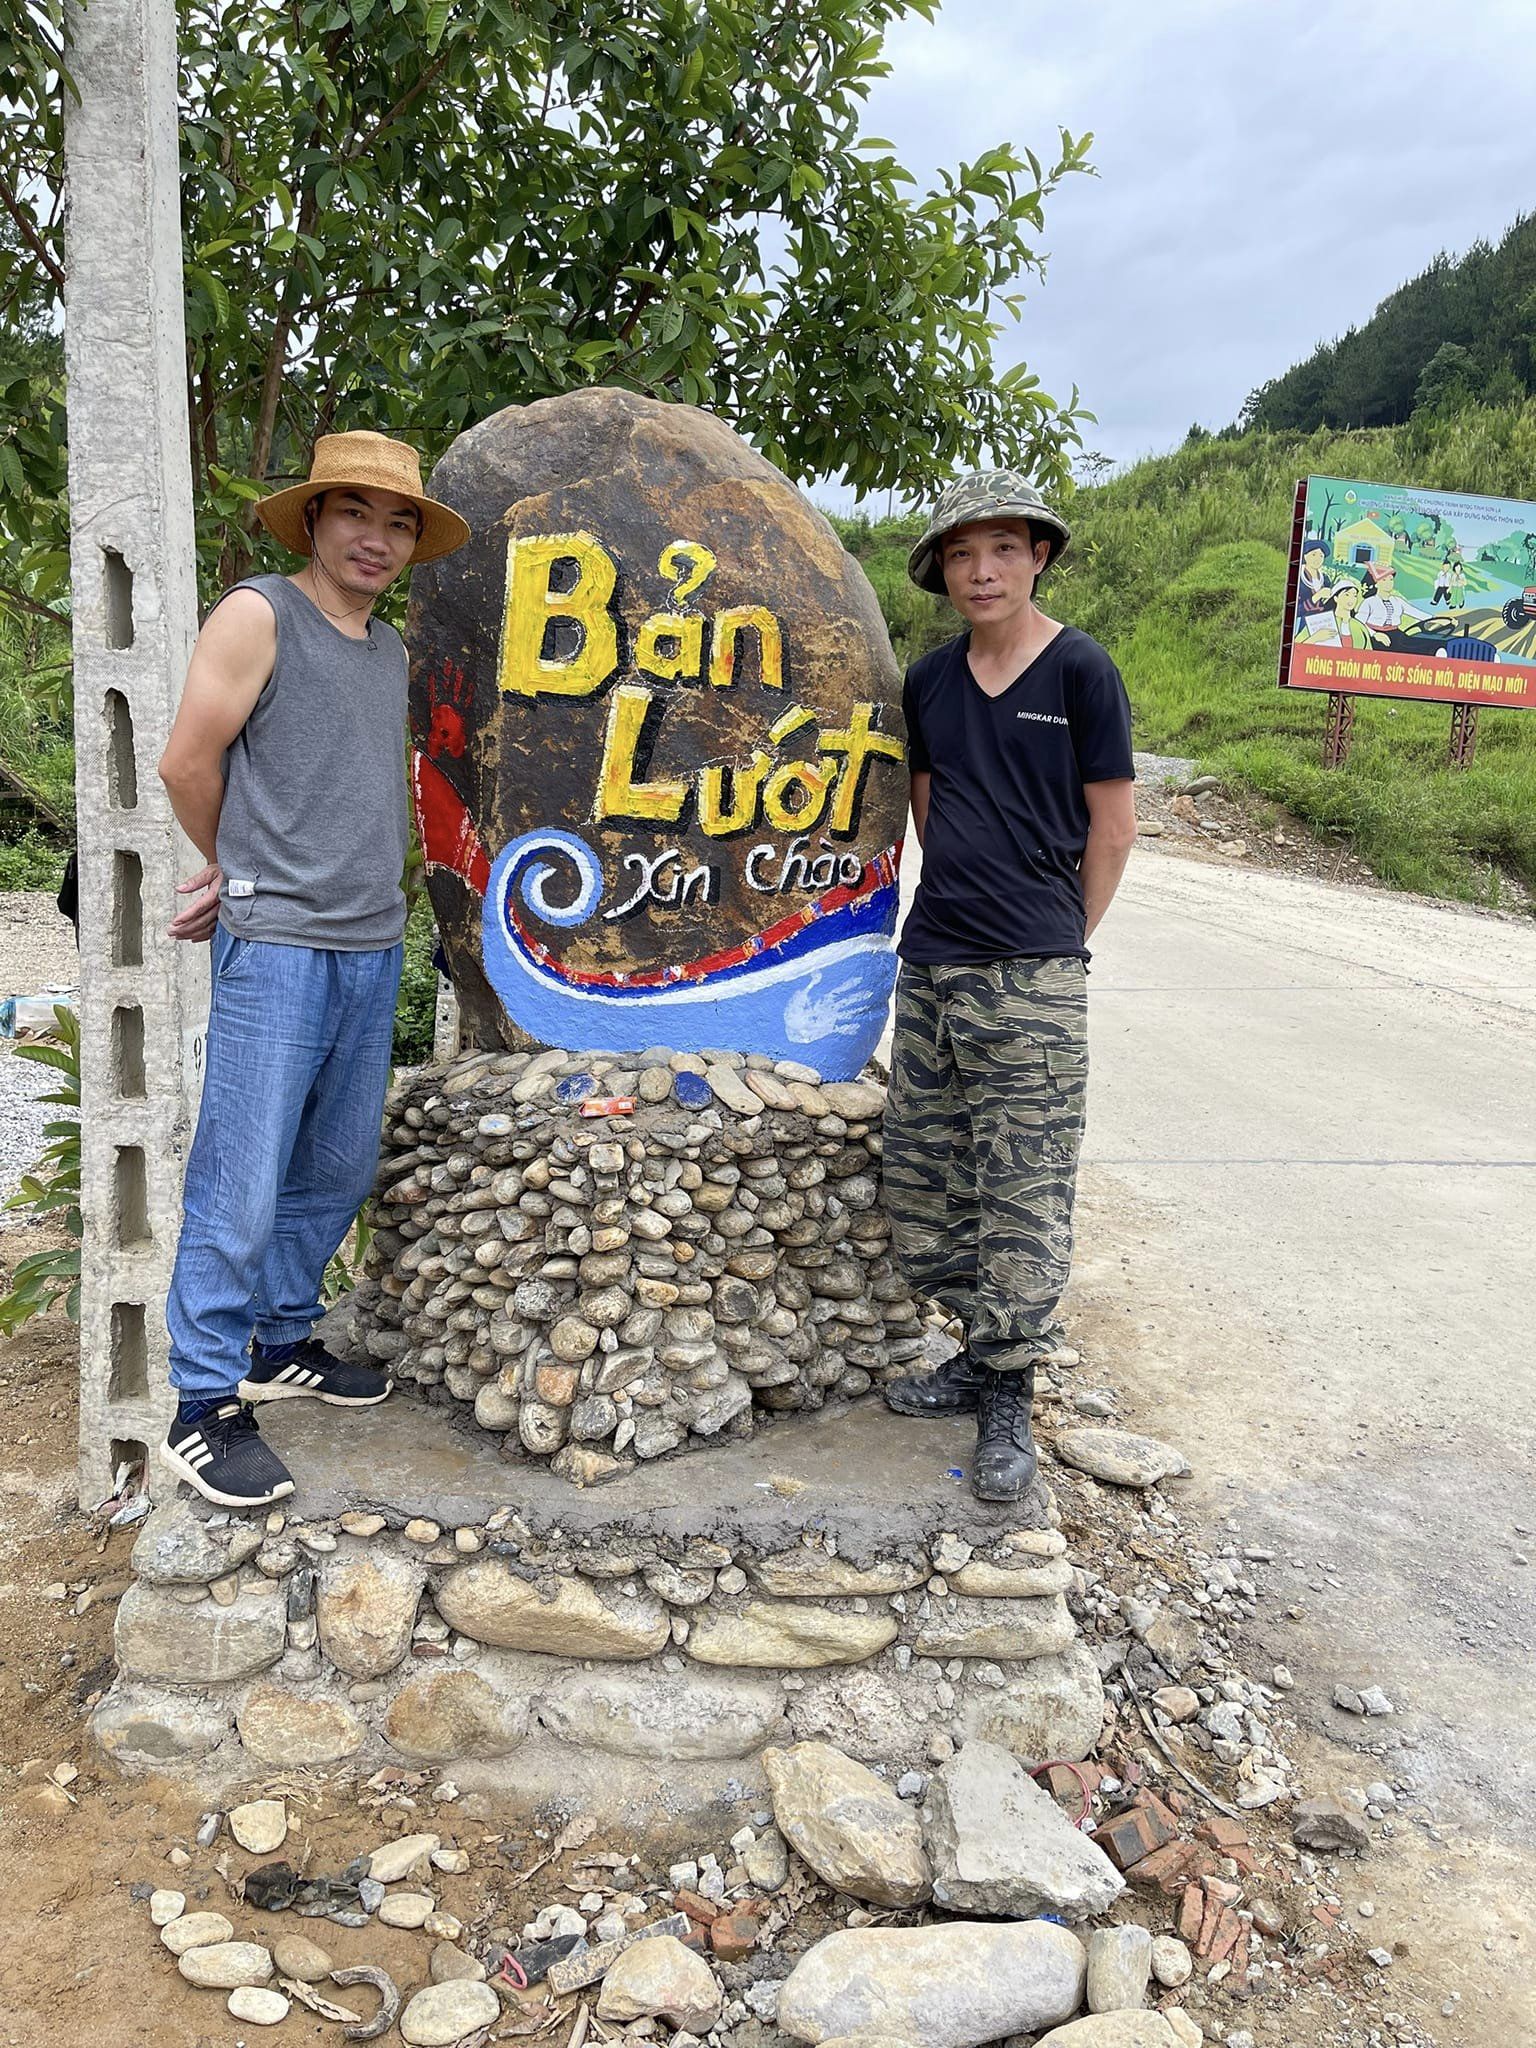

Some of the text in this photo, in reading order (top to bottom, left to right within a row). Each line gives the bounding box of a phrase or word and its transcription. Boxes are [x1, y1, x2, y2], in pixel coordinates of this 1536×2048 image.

[498, 529, 788, 700] Bản
[1305, 657, 1333, 676] NÔNG
[1335, 660, 1360, 679] THÔN
[1362, 662, 1383, 683] MỚI,
[1385, 664, 1405, 683] SỨC
[1406, 663, 1432, 686] SỐNG
[1434, 667, 1455, 689] MỚI,
[1458, 670, 1480, 693] DIỆN
[1482, 674, 1503, 695] MẠO
[1016, 711, 1052, 723] MINGKAR
[594, 685, 905, 840] Lướt
[603, 850, 719, 924] Xin
